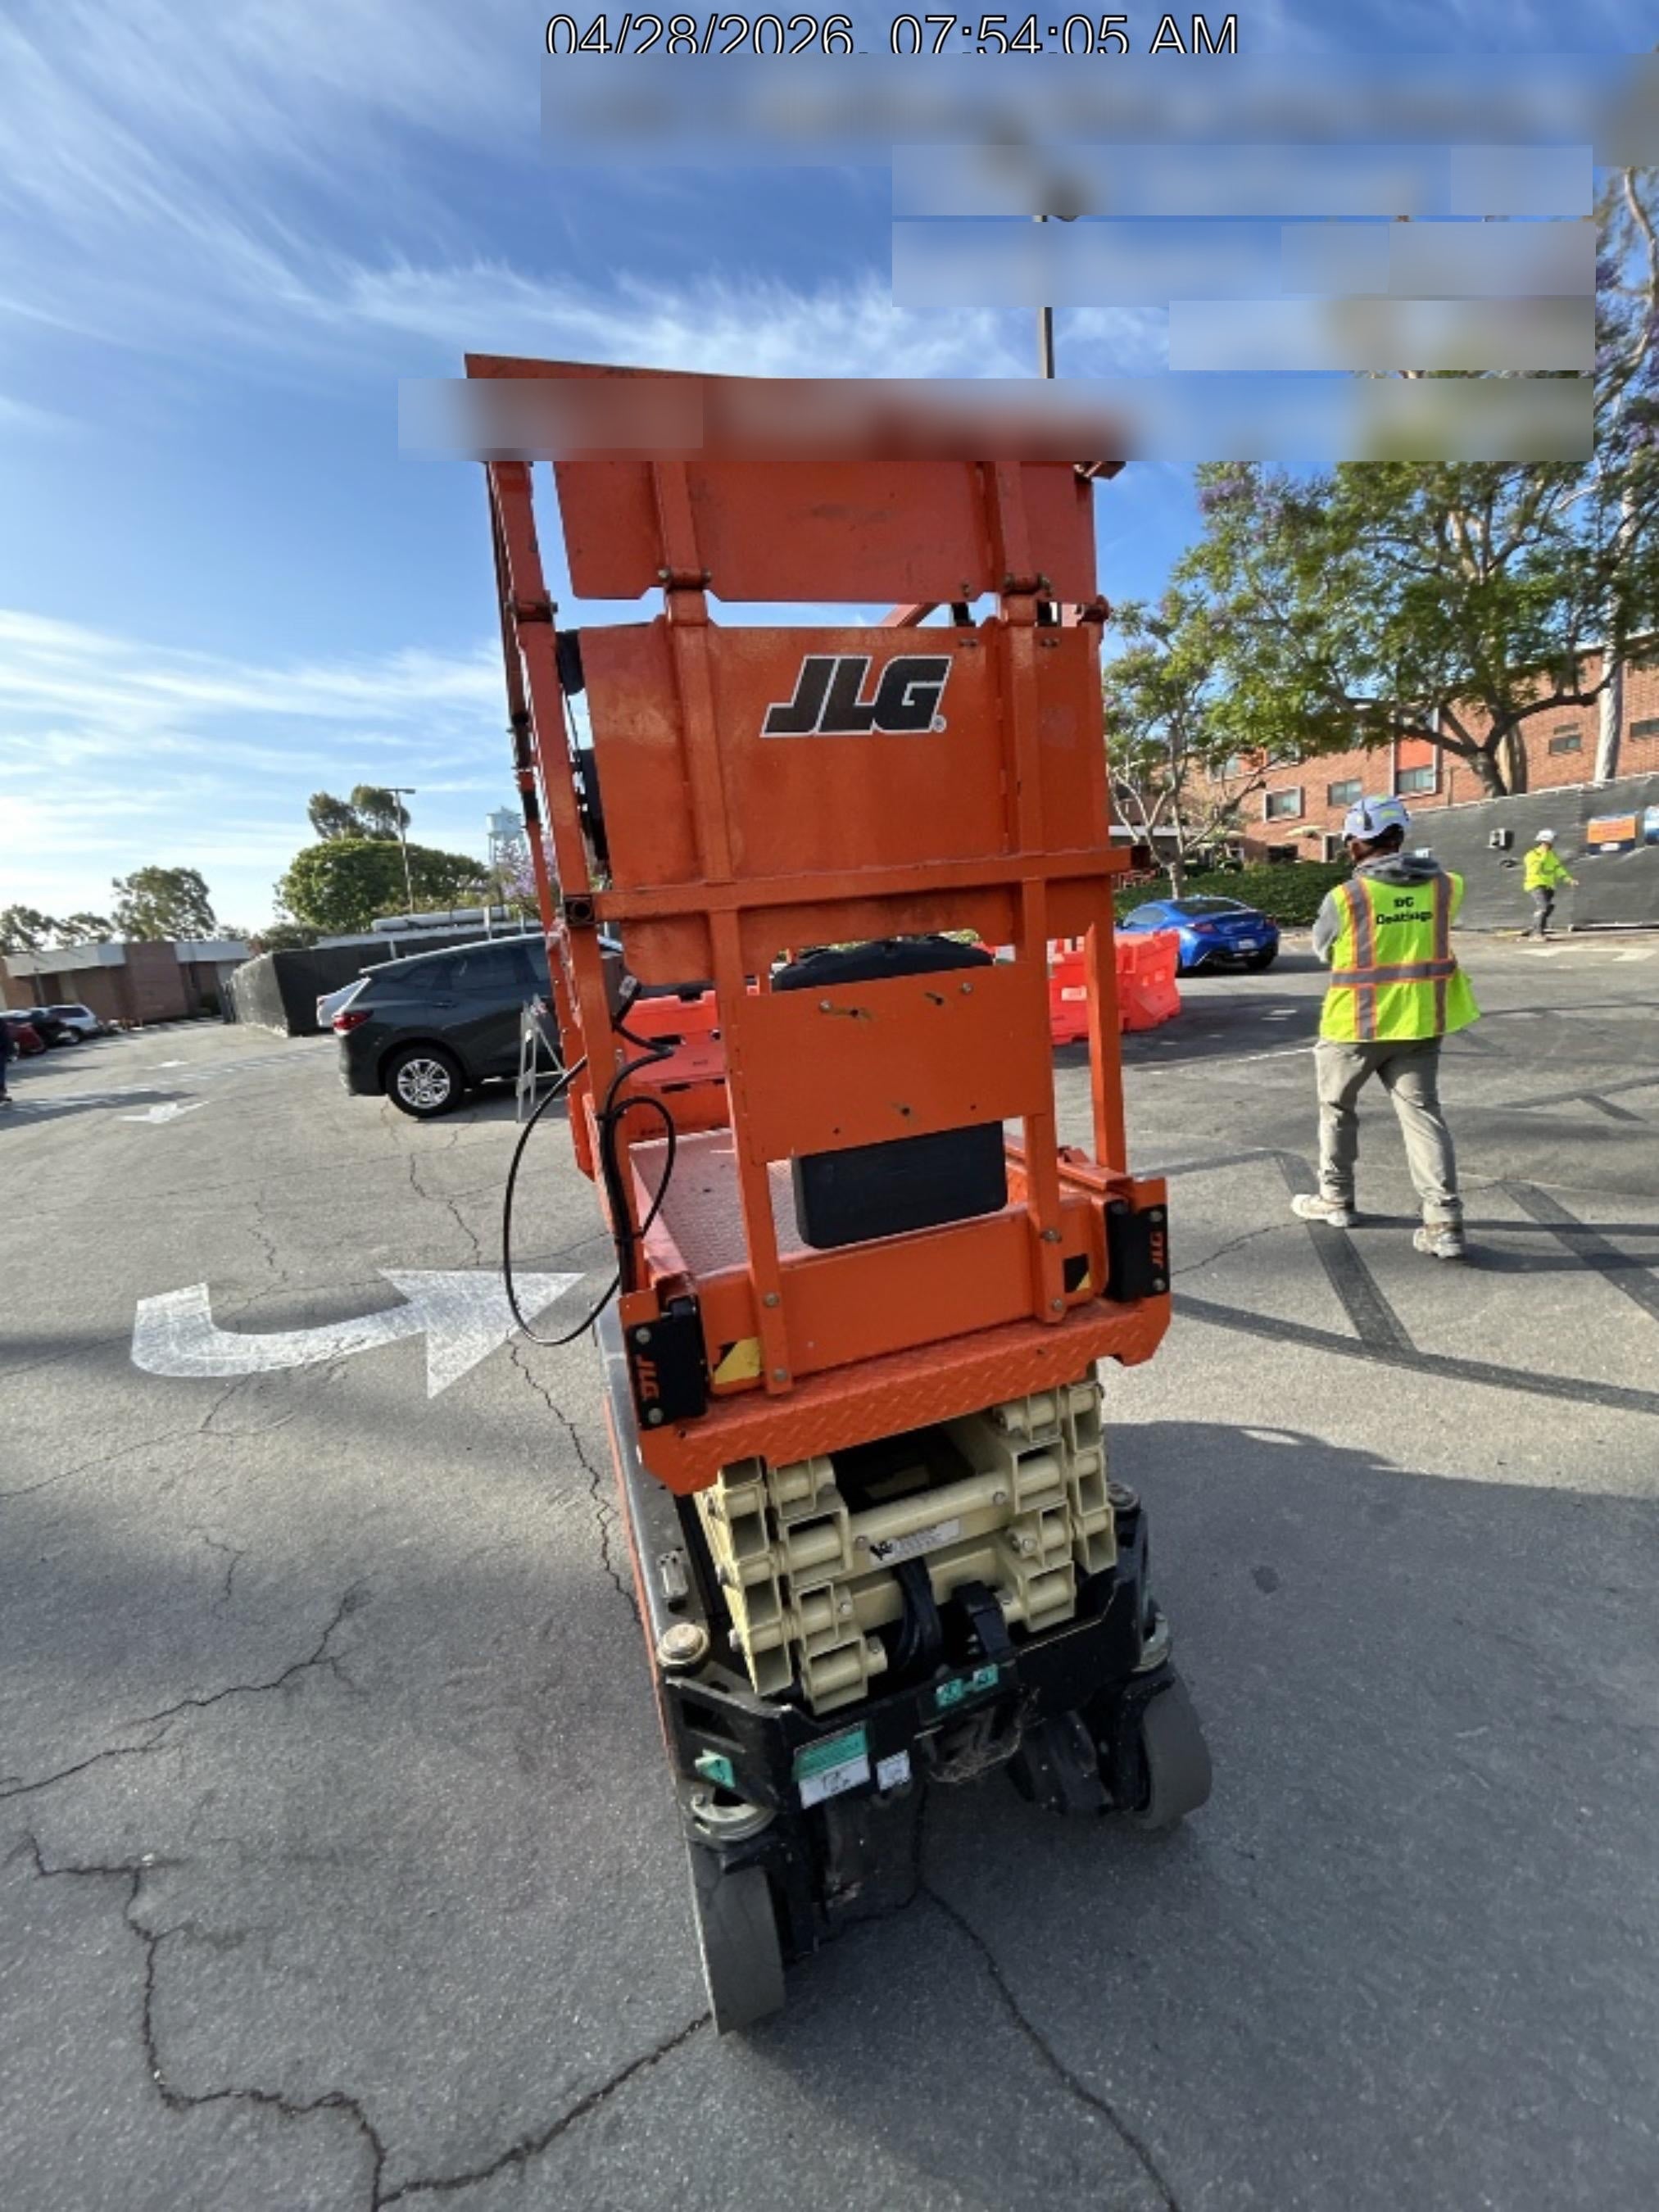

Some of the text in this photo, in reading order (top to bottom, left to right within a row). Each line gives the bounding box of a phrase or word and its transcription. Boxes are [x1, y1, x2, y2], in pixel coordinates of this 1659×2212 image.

[759, 655, 953, 737] JLG
[1149, 1231, 1164, 1269] JLG
[636, 1353, 660, 1402] JLG
